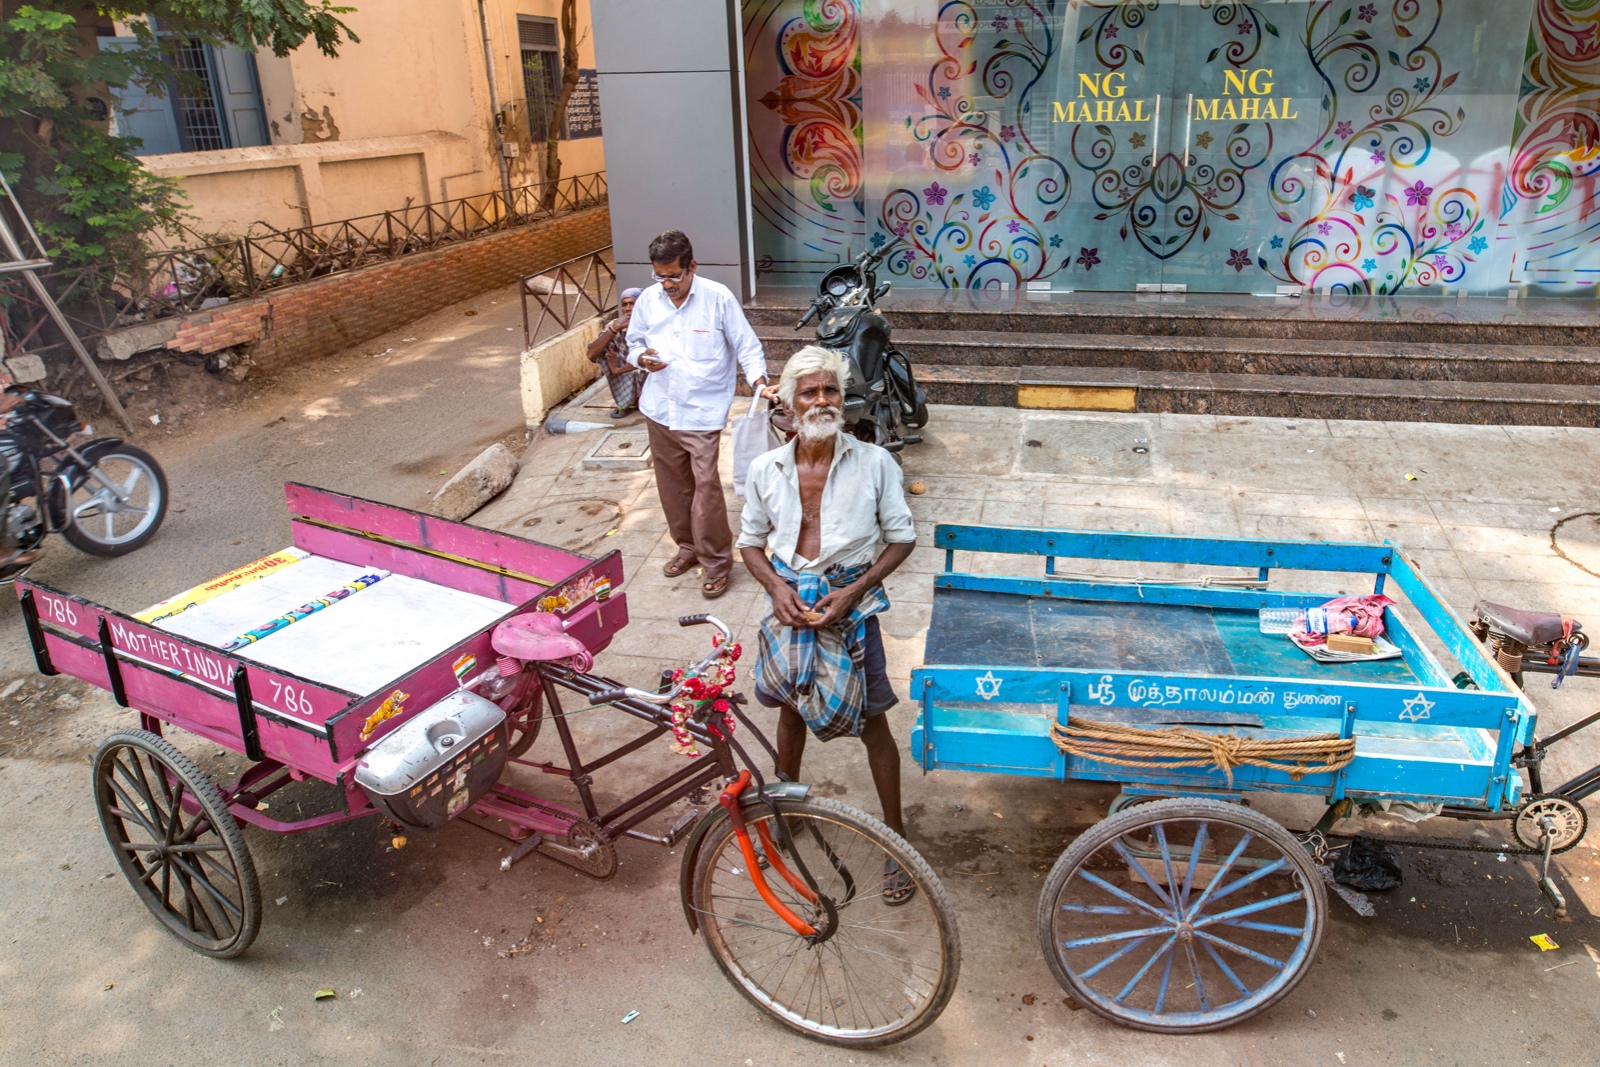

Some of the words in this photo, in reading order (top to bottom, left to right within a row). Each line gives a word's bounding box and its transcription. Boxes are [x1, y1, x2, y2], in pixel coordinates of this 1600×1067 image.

[1077, 71, 1128, 98] NG
[1221, 68, 1275, 95] NG
[1052, 100, 1151, 123] MAHAL
[1194, 97, 1299, 120] MAHAL
[41, 595, 78, 627] 786
[110, 621, 183, 667] MOTHER
[181, 646, 234, 687] INDIA
[268, 679, 314, 715] 786
[1127, 679, 1275, 707] முத்தாலம்மன்
[1283, 691, 1342, 709] துணை
